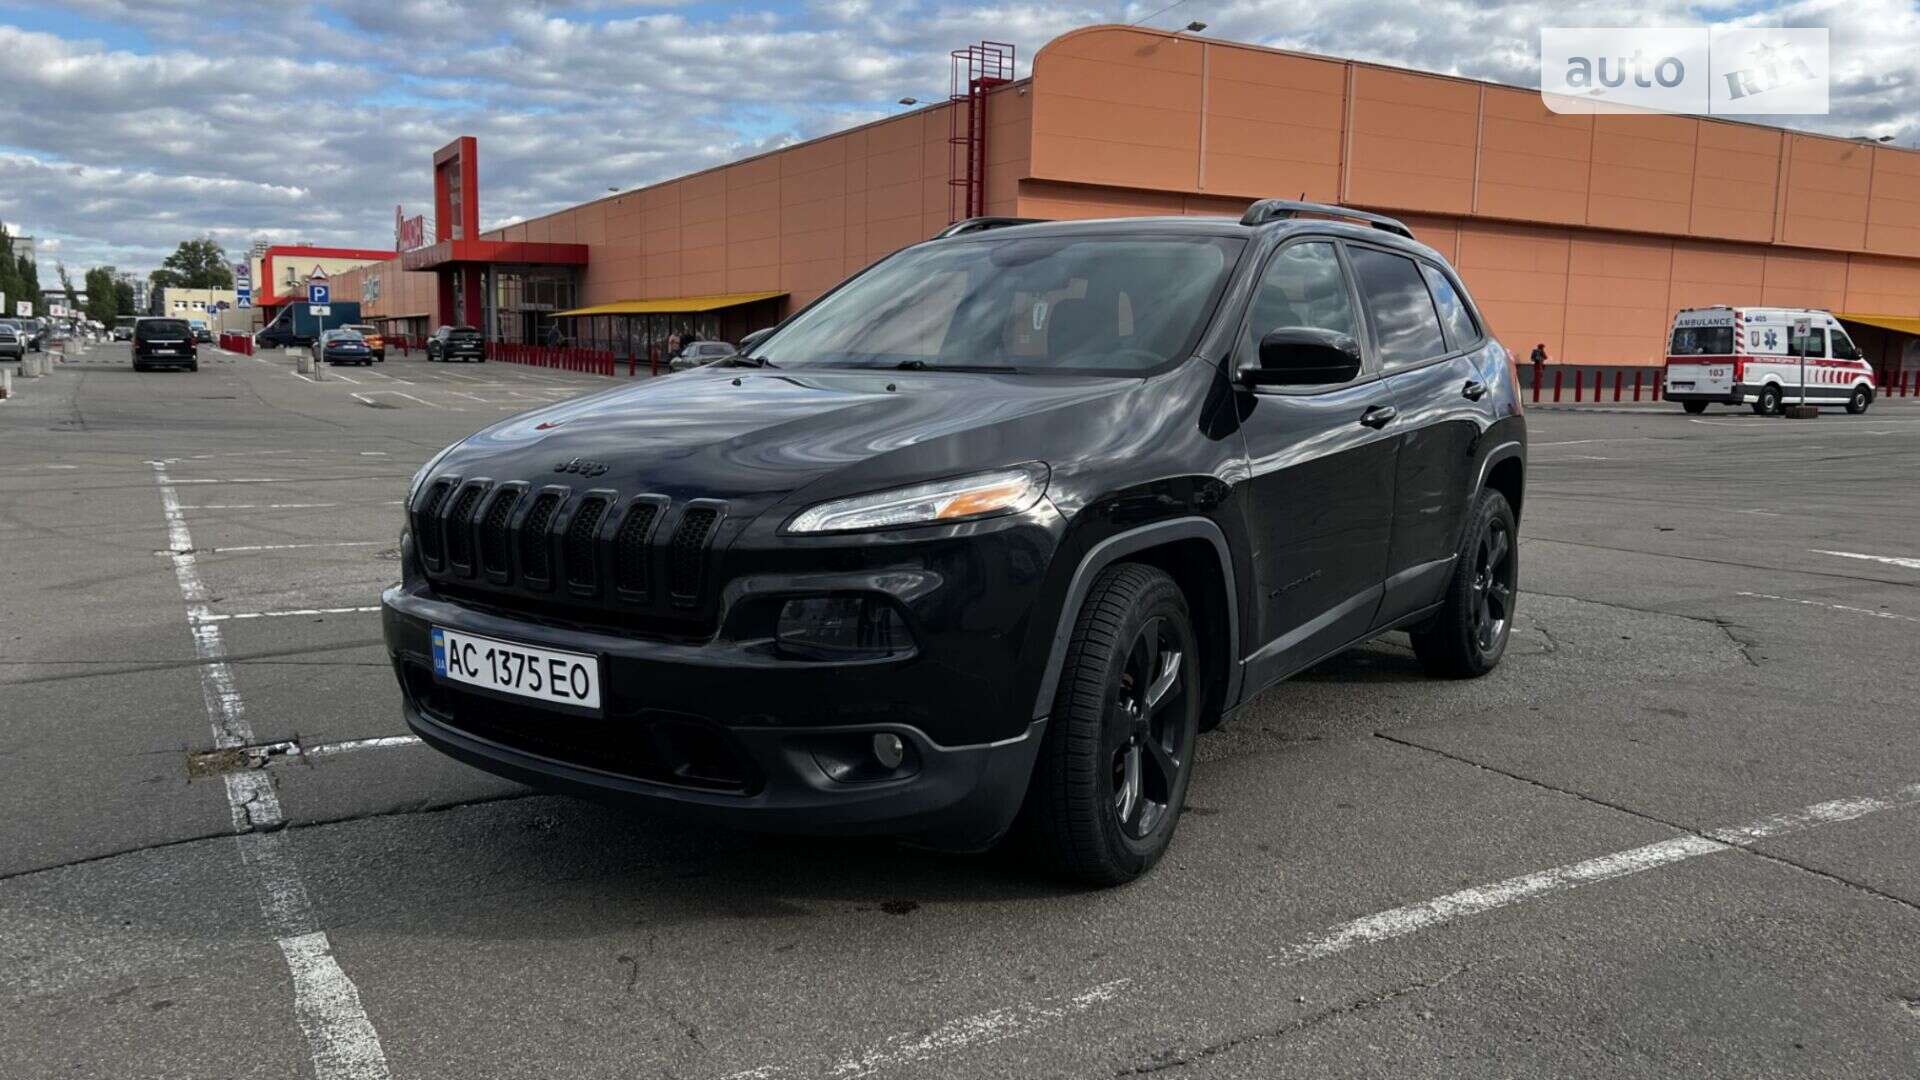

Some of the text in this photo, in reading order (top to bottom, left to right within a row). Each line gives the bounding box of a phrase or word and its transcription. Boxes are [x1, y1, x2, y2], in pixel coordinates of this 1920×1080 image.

[314, 287, 326, 302] P
[1679, 318, 1731, 326] AMBULANCE
[1709, 369, 1724, 377] 103
[554, 457, 609, 478] Jeep
[436, 657, 446, 669] UA
[449, 638, 590, 700] AC 1375 EO
